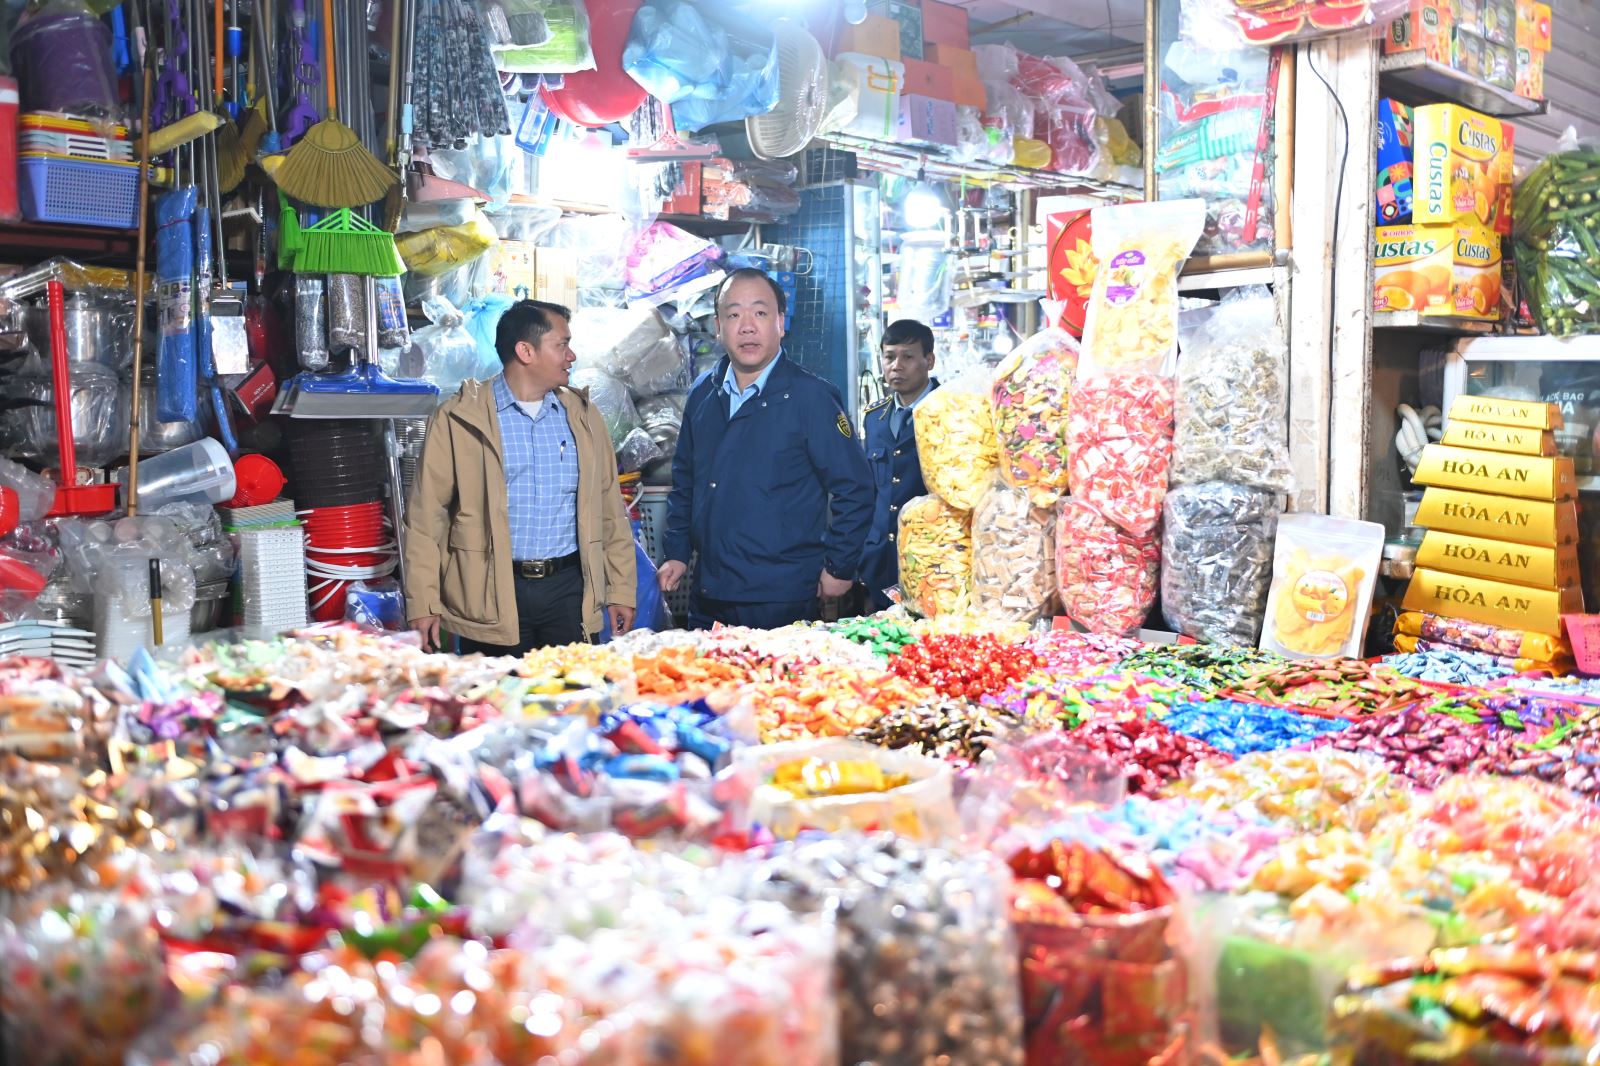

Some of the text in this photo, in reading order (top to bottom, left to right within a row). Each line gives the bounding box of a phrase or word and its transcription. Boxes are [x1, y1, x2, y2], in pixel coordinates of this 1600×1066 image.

[1458, 121, 1496, 153] Custas
[1429, 141, 1448, 214] Custas
[1375, 239, 1435, 258] ustas
[1457, 238, 1490, 260] Custas
[1496, 467, 1529, 482] AN
[1496, 510, 1530, 527] AN
[1443, 543, 1532, 569] HÒA AN
[1433, 585, 1532, 610] HÒA AN
